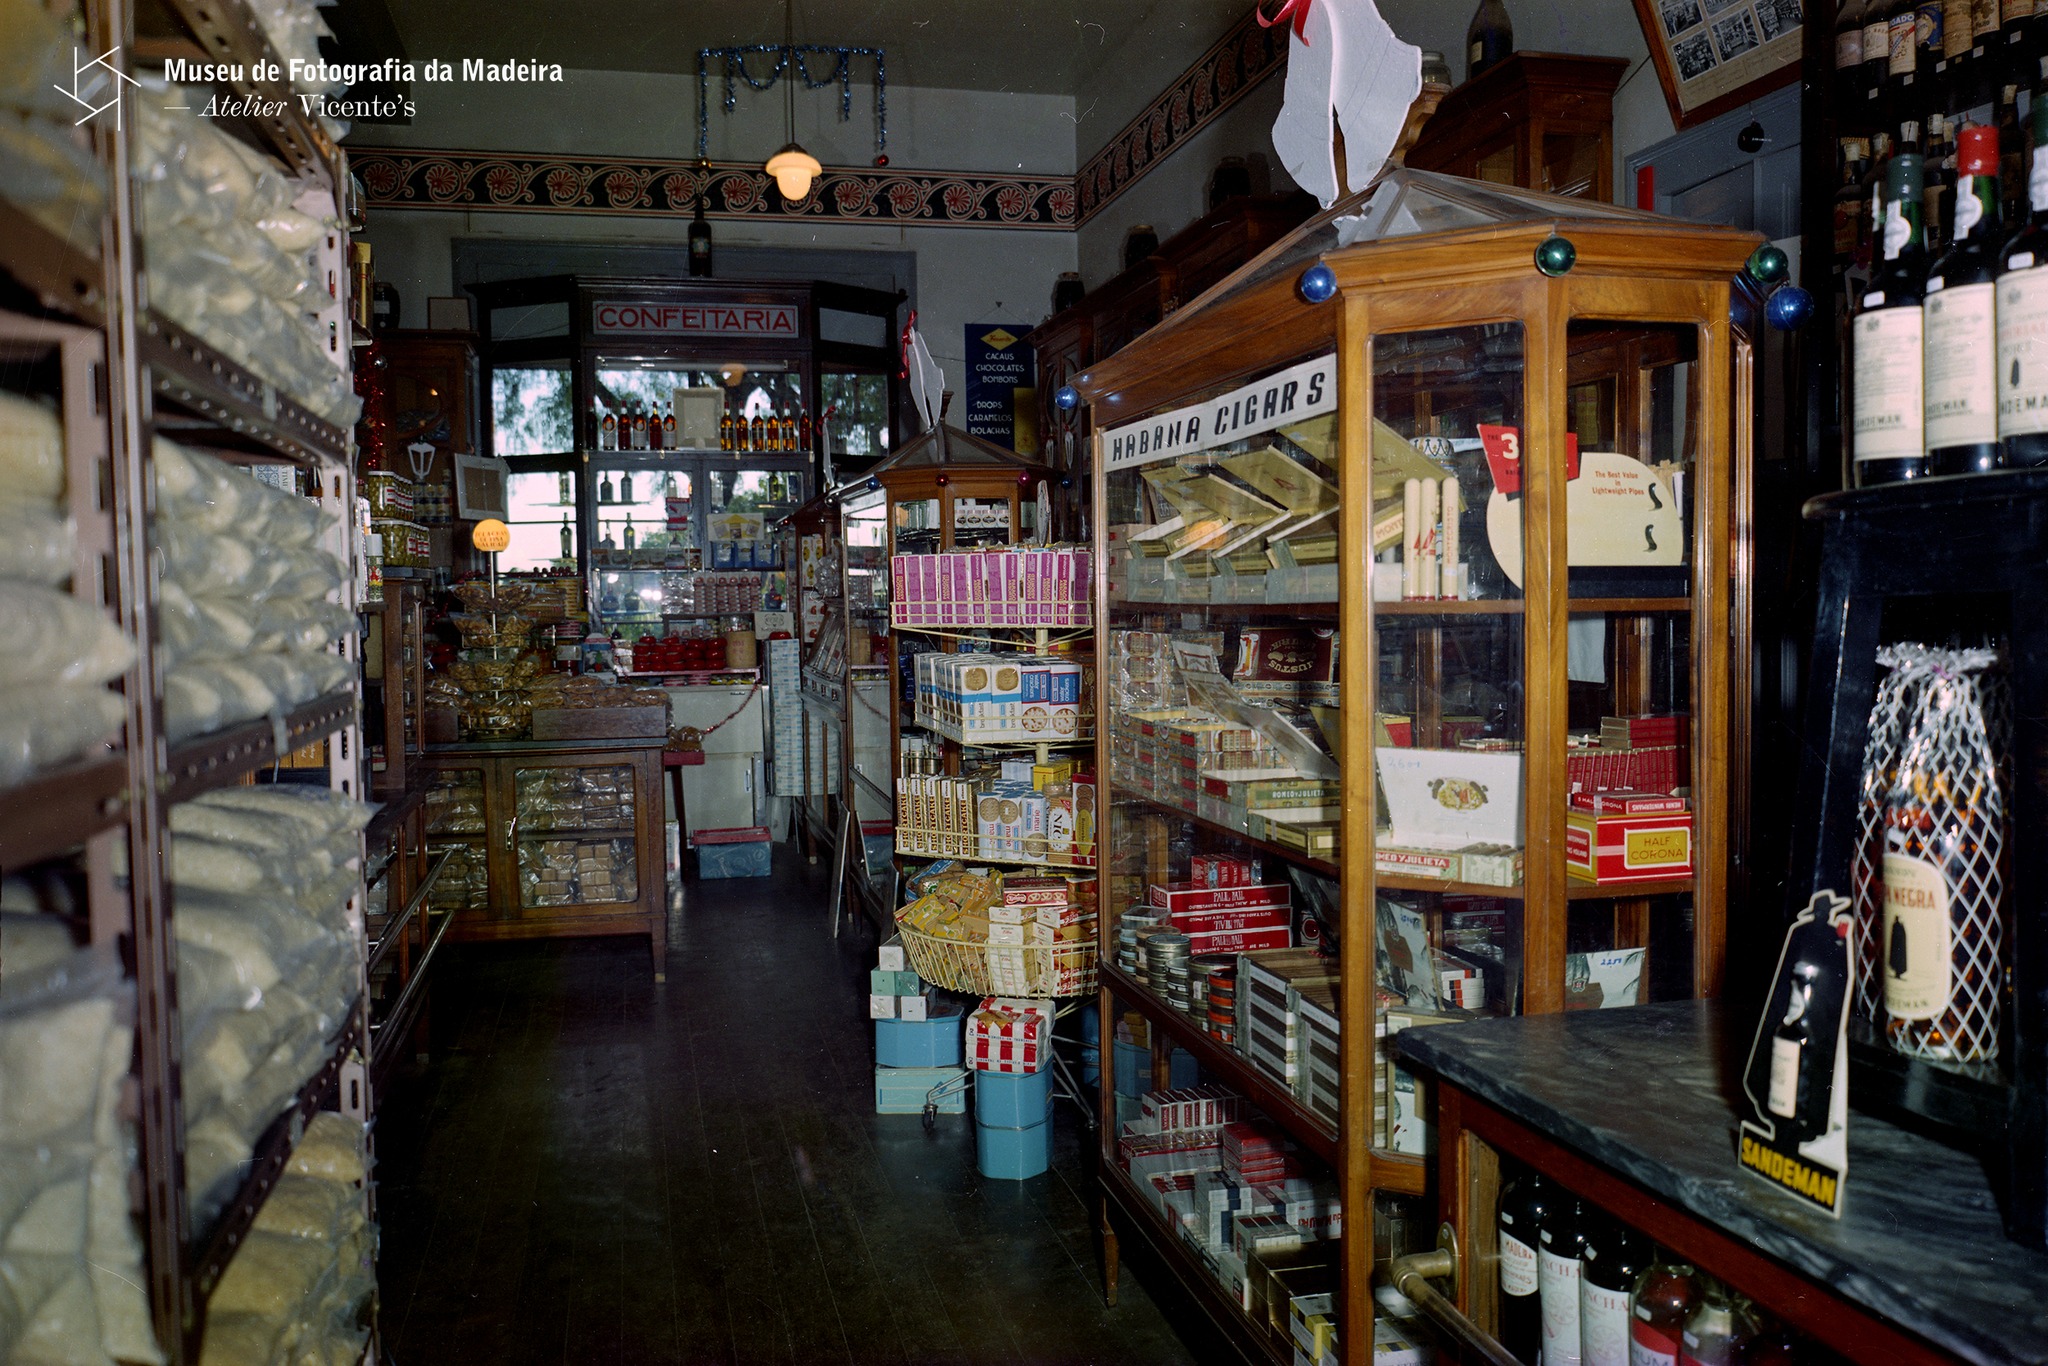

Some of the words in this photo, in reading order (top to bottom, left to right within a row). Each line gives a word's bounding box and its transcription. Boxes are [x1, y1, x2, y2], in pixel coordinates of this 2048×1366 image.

[599, 307, 793, 331] CONFEITARIA
[985, 352, 1014, 361] CACAUS
[975, 364, 1025, 373] CHOCOLATES
[982, 375, 1019, 384] BOMBONS
[976, 400, 1003, 409] DROPS
[968, 413, 1012, 422] CARAMELOS
[1112, 416, 1200, 462] HABANA
[1214, 372, 1325, 436] CIGARS
[970, 426, 1011, 435] BOLACHAS
[1500, 432, 1520, 460] 3
[1595, 470, 1606, 479] The
[1607, 471, 1621, 479] Best
[1622, 471, 1639, 479] Value
[1592, 487, 1627, 496] Lightweight
[1628, 488, 1645, 496] Pipes
[1268, 659, 1313, 674] JUSTUS
[1272, 790, 1294, 799] ROMEO
[1582, 797, 1595, 805] HAL
[1600, 801, 1623, 810] ORONA
[1644, 836, 1670, 847] HALF
[1631, 848, 1684, 861] CORONA
[1405, 854, 1447, 867] JULIETA
[1893, 887, 1936, 910] NEGRA
[1191, 946, 1221, 954] UTSTANDING
[1741, 1137, 1837, 1207] SANDEMAN
[1504, 1240, 1533, 1260] MADEIRA
